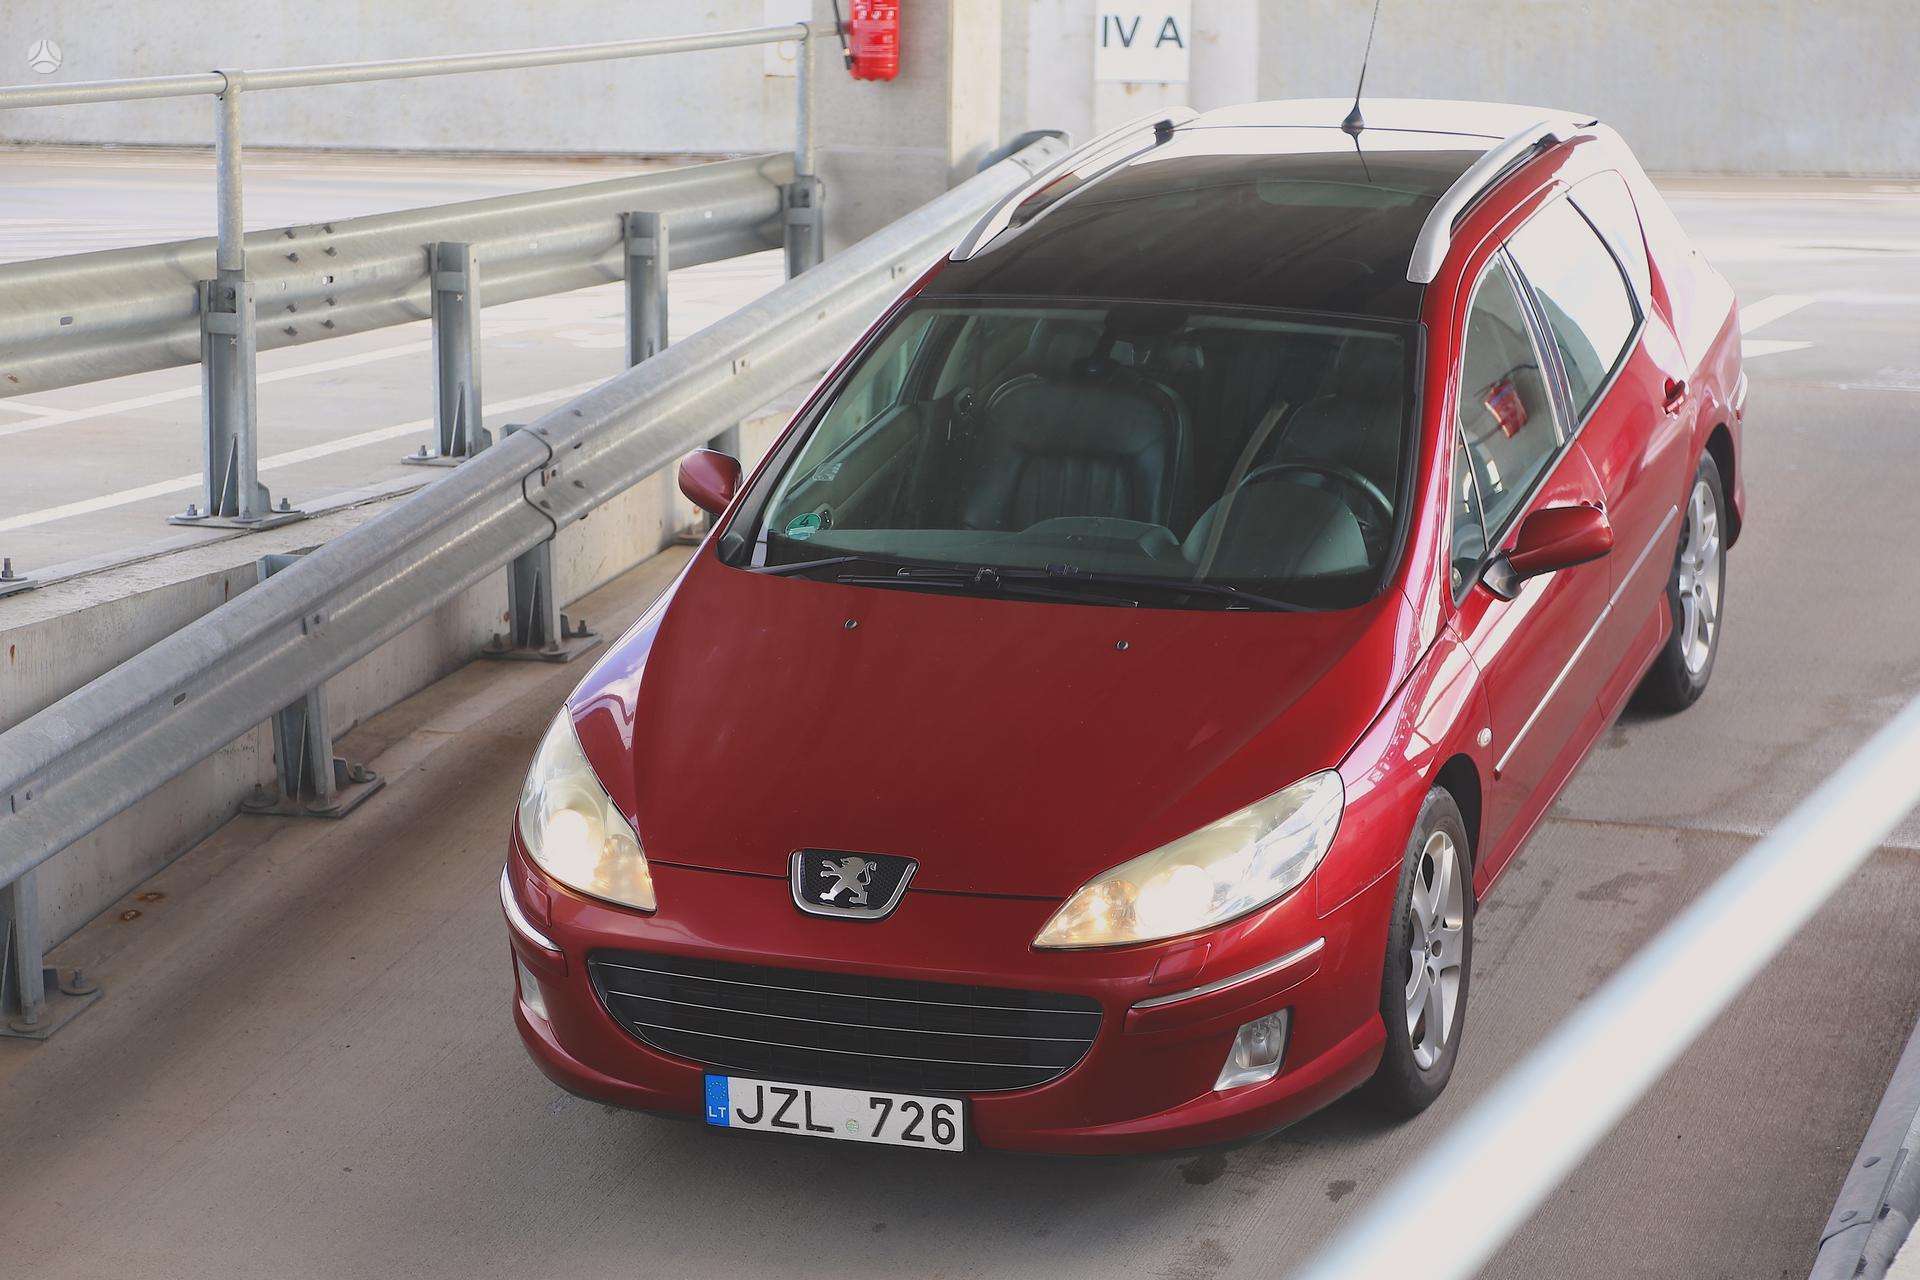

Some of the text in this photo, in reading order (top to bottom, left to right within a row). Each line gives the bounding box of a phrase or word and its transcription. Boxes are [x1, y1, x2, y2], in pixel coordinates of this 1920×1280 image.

[1103, 15, 1183, 48] IV A
[708, 1105, 727, 1118] LT
[736, 1085, 956, 1145] JZL 726
